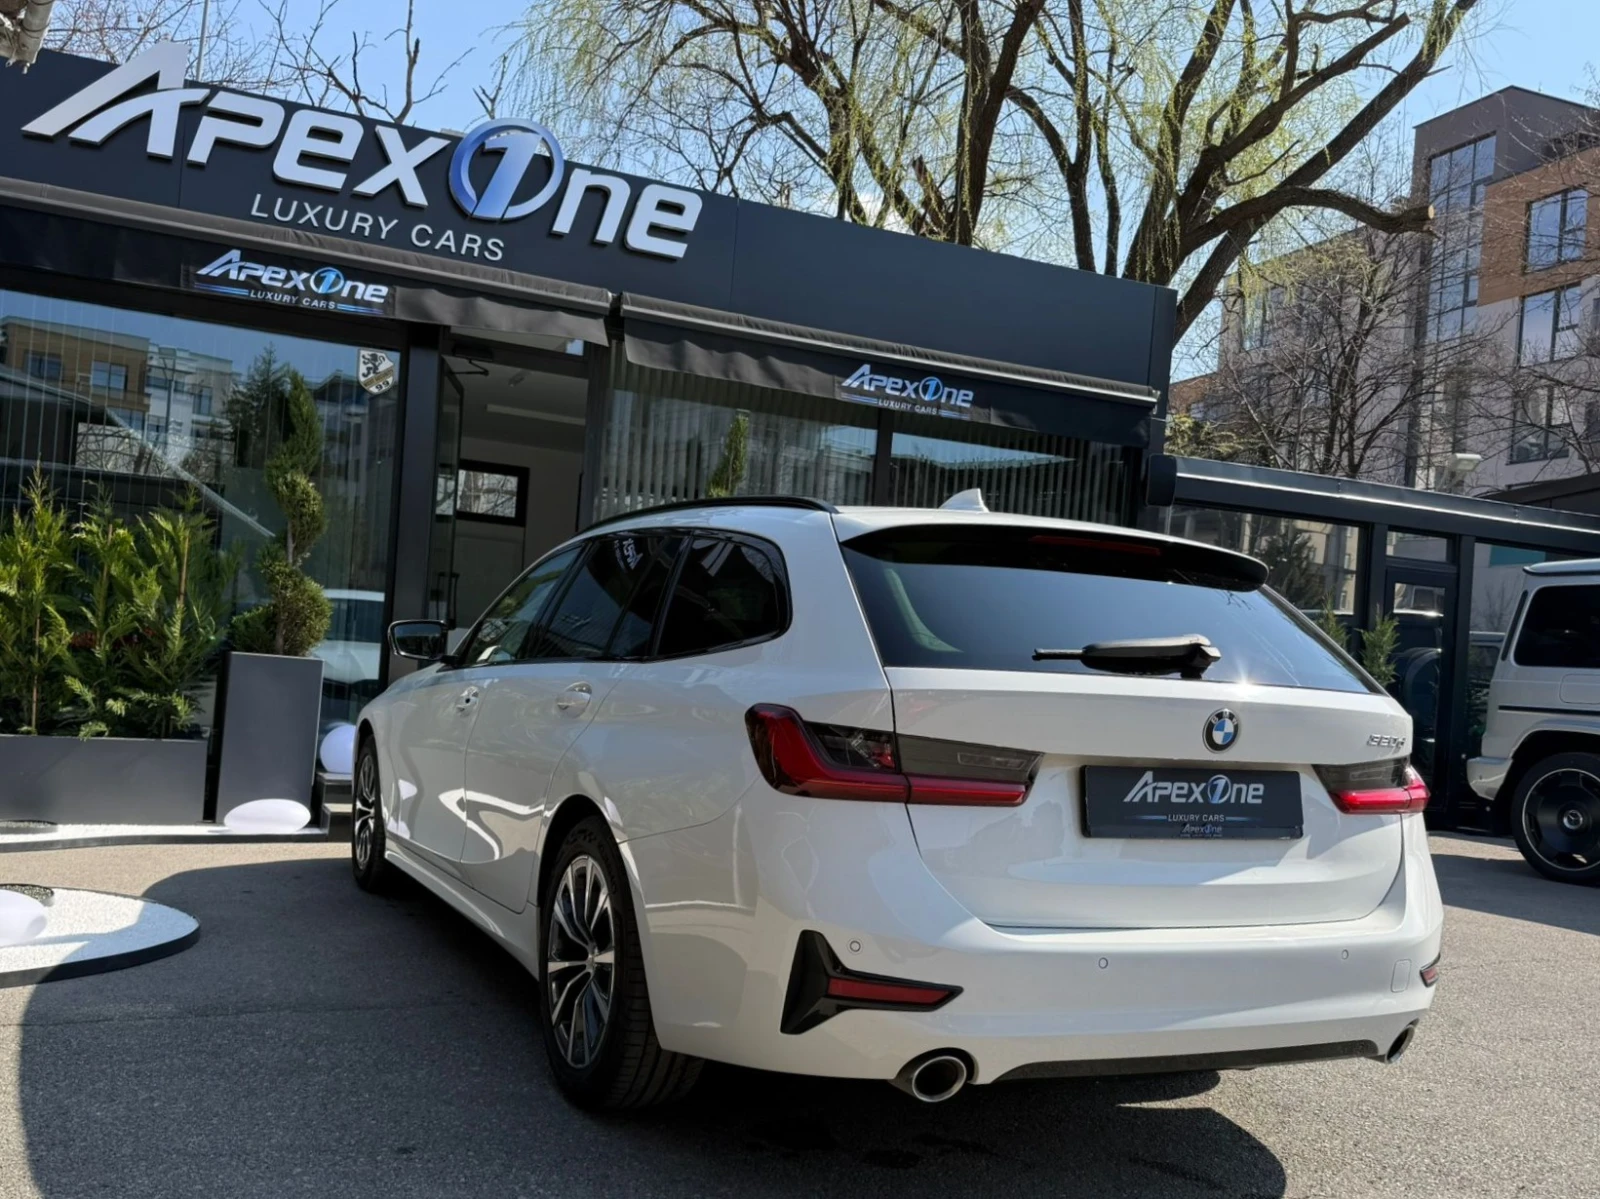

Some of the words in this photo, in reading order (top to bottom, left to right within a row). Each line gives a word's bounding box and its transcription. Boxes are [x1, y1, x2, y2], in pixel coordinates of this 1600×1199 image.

[250, 192, 399, 241] LUXURY
[410, 223, 506, 262] CARS
[250, 289, 298, 304] LUXURY
[302, 298, 336, 309] CARS
[878, 398, 911, 410] LUXURY
[915, 405, 938, 415] CARS
[1168, 814, 1200, 822] LUXURY
[1202, 814, 1225, 822] CARS
